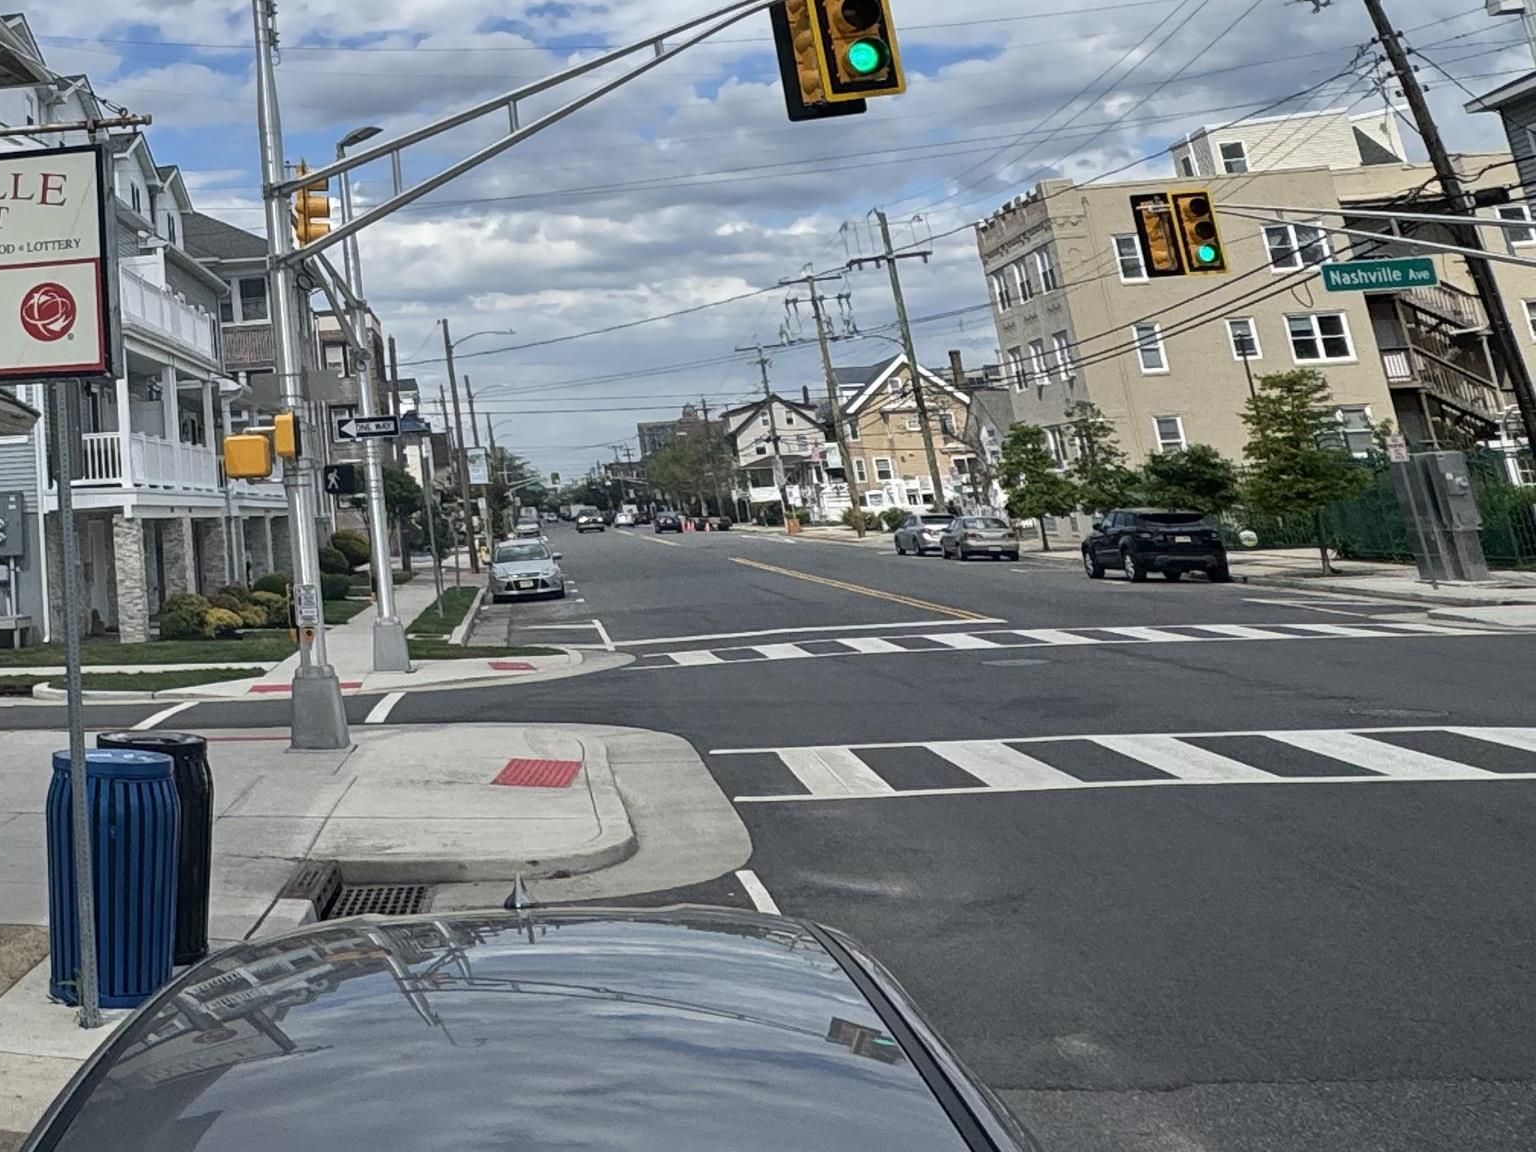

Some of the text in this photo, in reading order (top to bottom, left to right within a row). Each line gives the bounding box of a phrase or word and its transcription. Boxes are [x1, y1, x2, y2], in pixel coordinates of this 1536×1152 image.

[26, 238, 82, 253] LOTTERY
[1329, 267, 1431, 286] Nashville Ave
[356, 422, 392, 432] ONE WAY
